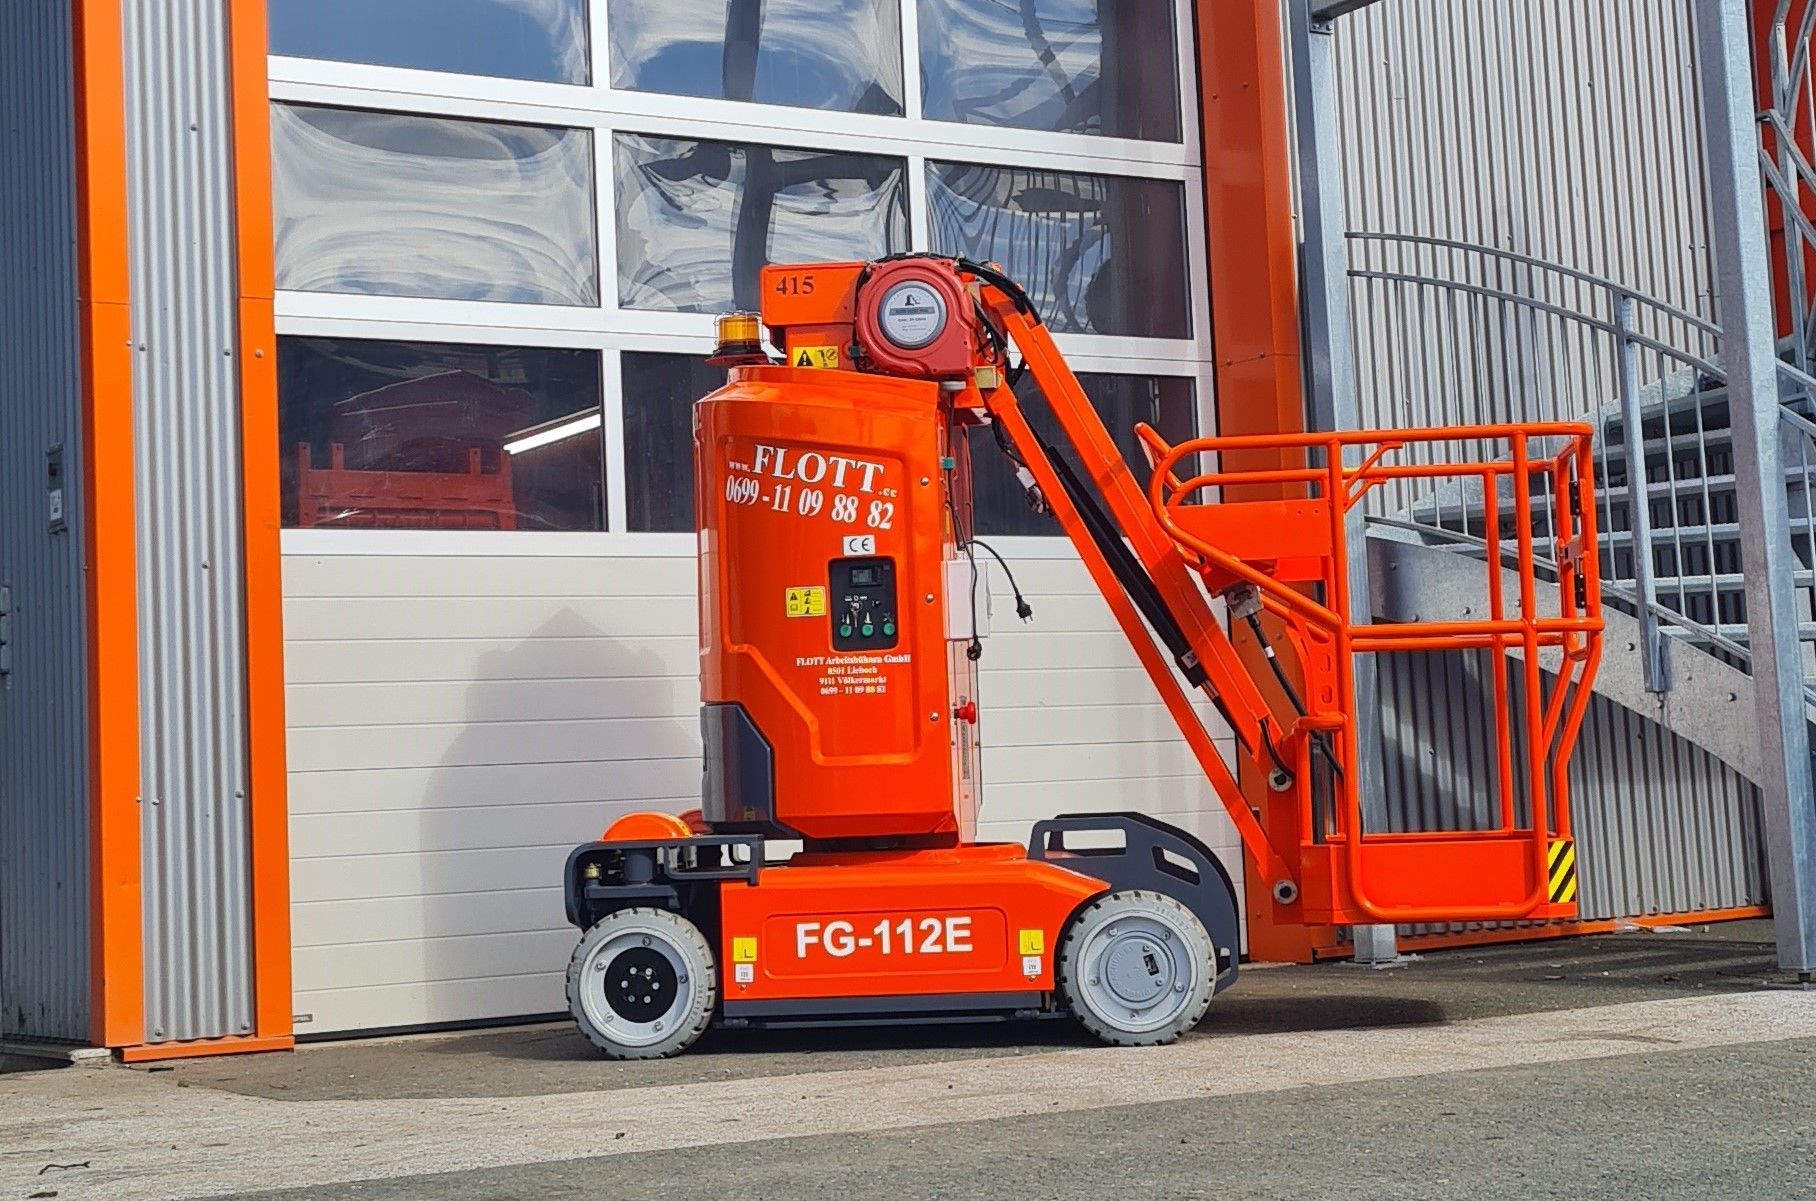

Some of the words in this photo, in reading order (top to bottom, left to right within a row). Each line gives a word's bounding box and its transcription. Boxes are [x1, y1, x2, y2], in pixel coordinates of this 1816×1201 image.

[775, 275, 815, 295] 415
[726, 475, 760, 506] 0699
[771, 483, 792, 513] 11
[798, 488, 824, 516] 09
[831, 494, 859, 523] 88
[867, 500, 895, 530] 82
[796, 657, 825, 666] FLOTT
[883, 654, 912, 663] GmbH
[820, 687, 838, 695] 0699
[796, 917, 973, 959] FG-112E
